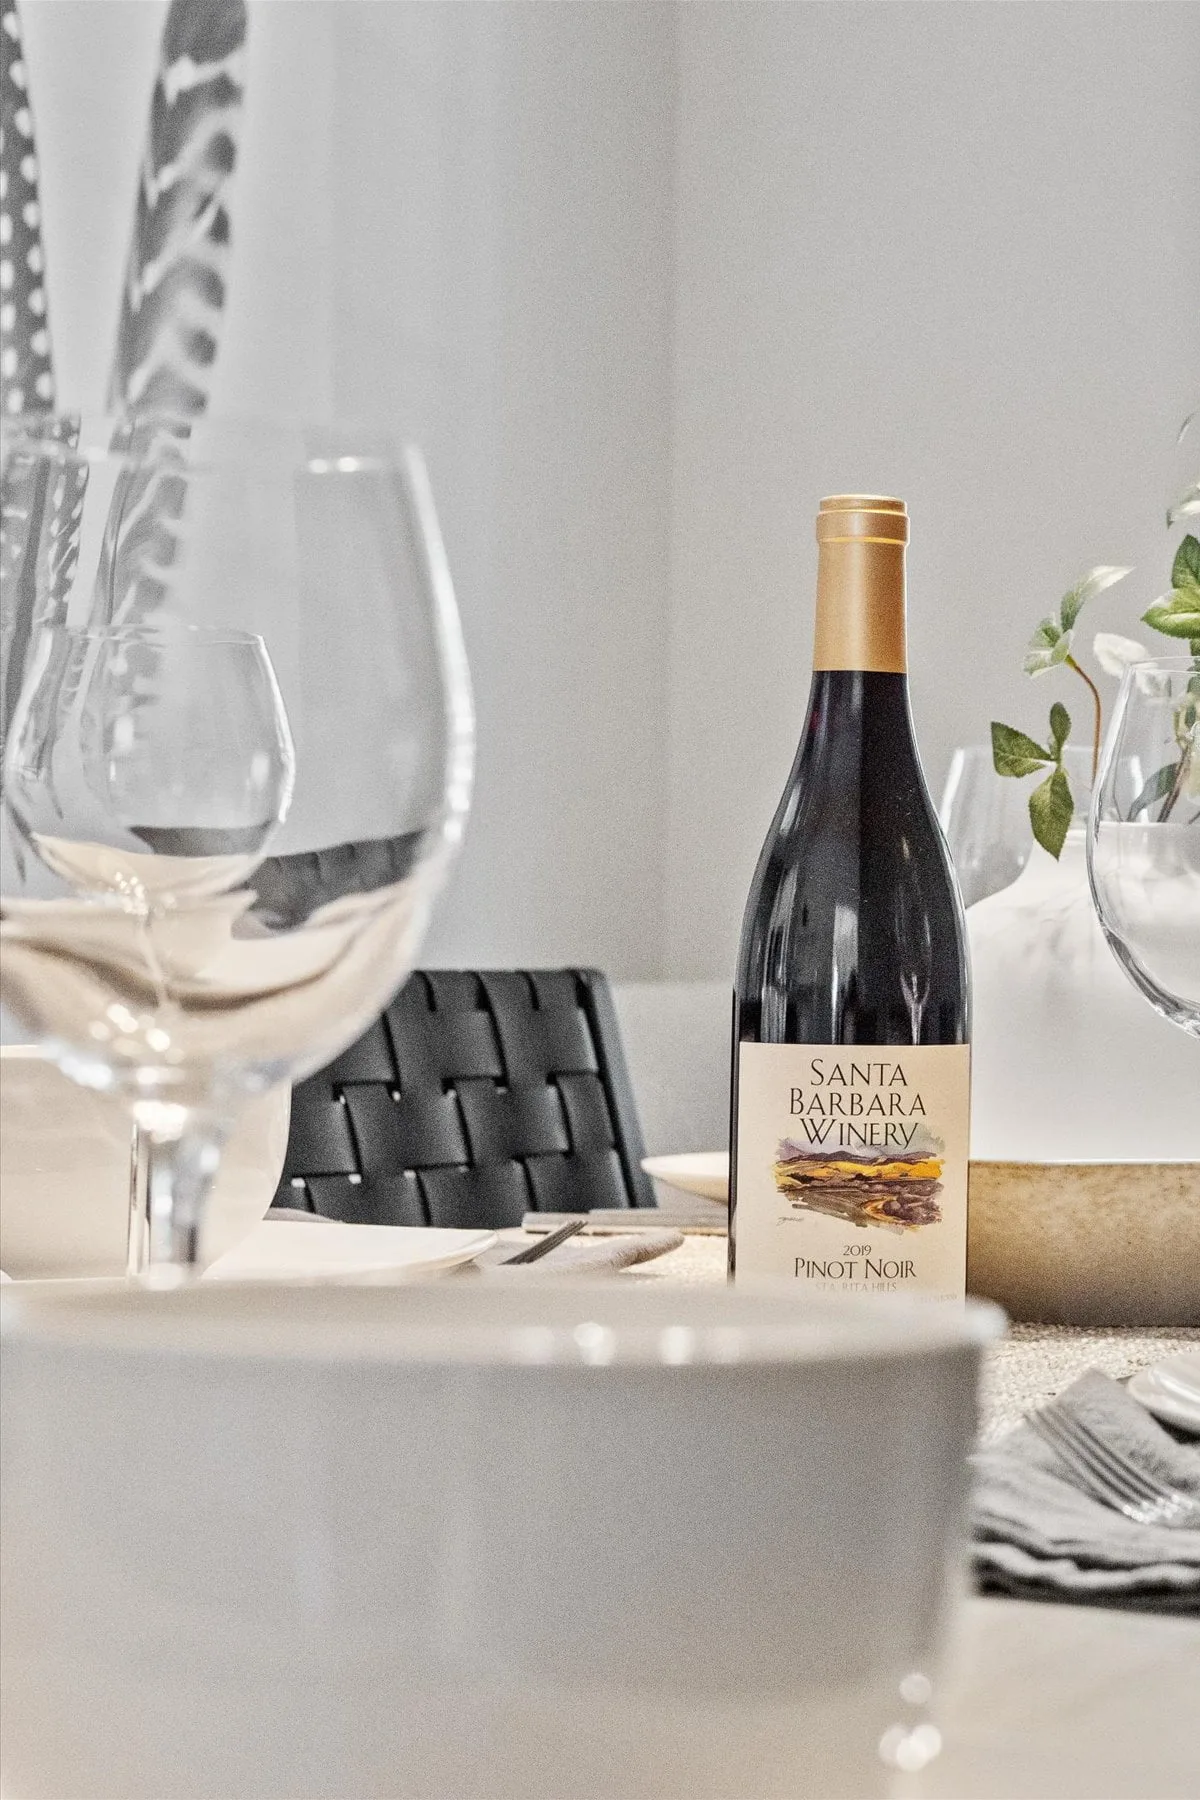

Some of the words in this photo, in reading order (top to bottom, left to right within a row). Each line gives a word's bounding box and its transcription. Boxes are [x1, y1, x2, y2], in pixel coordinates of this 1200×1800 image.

[810, 1058, 908, 1087] SANTA
[789, 1088, 926, 1116] BARBARA
[800, 1118, 919, 1149] WINERY
[843, 1244, 872, 1256] 2019
[794, 1257, 858, 1279] PINOT
[864, 1258, 917, 1278] NOIR
